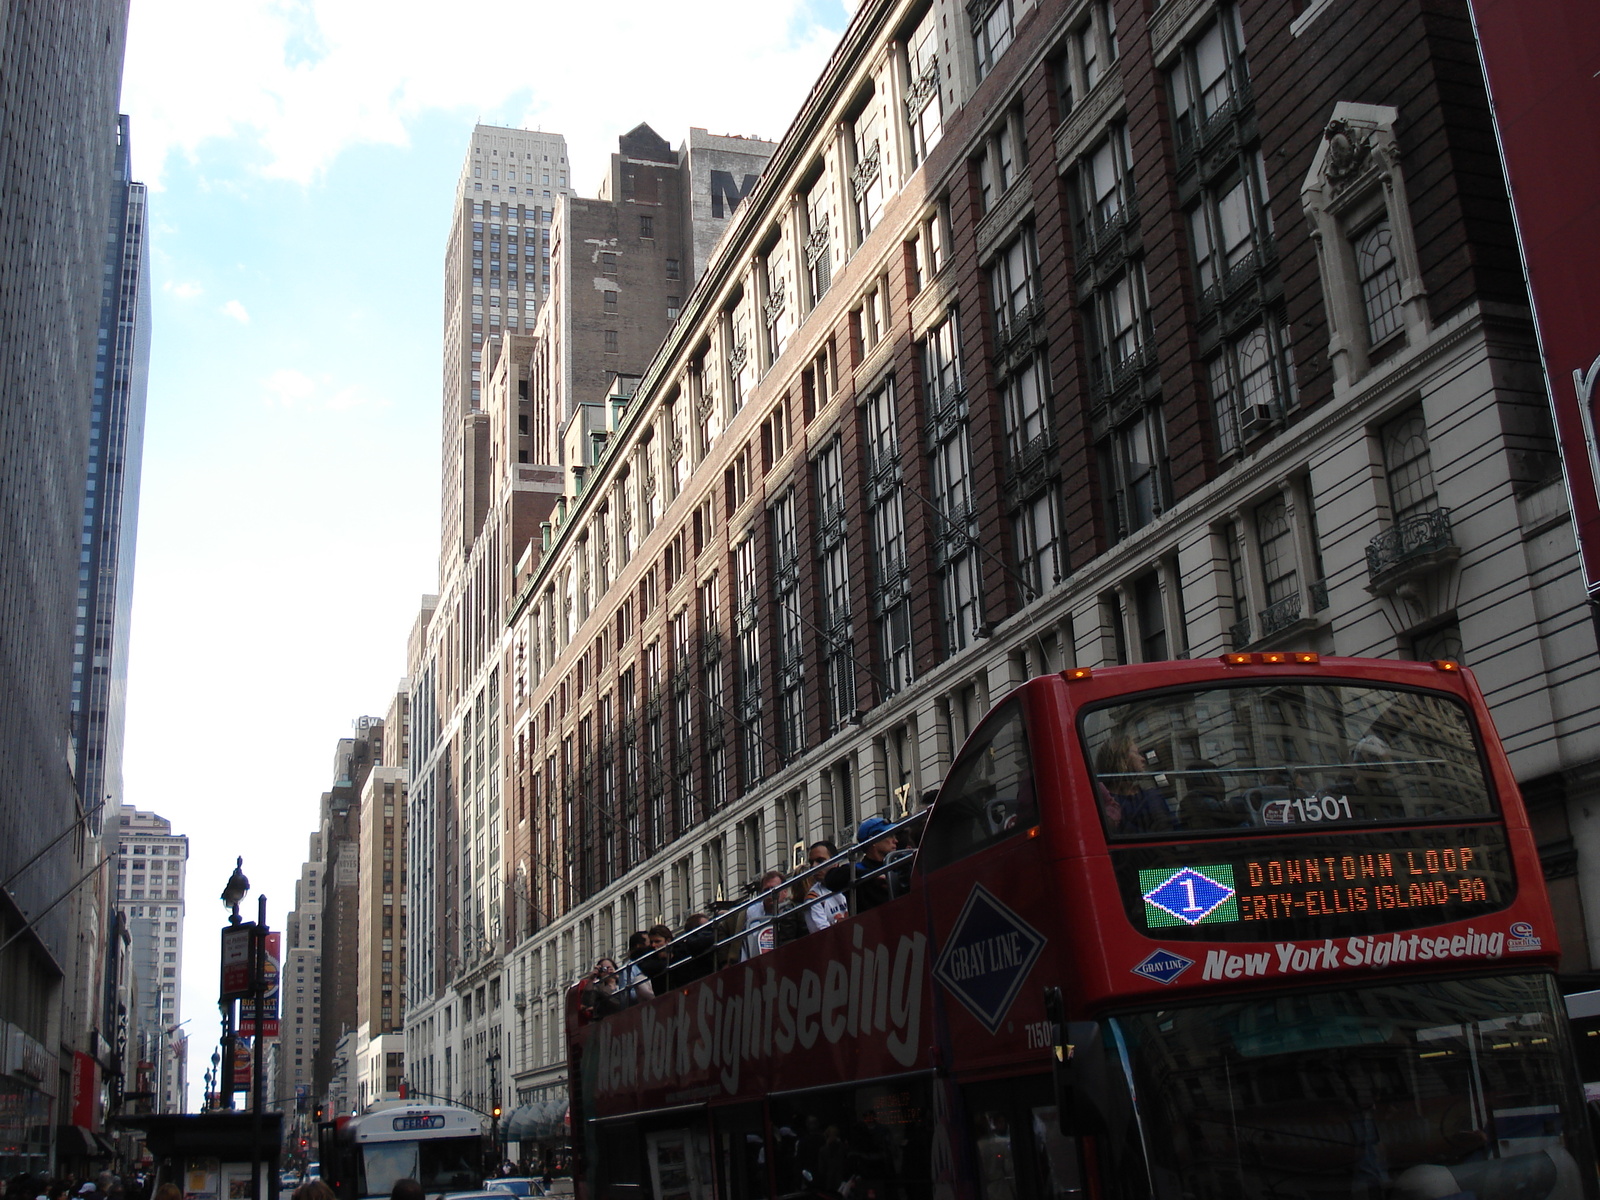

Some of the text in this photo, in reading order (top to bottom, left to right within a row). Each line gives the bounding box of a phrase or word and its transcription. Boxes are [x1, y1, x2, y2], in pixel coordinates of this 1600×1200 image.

[1275, 795, 1352, 823] 71501
[1248, 847, 1474, 888] DOWNTOWN LOOP
[1179, 878, 1202, 912] 1
[950, 931, 1023, 982] GRAY LINE
[1142, 959, 1184, 973] GRAY LINE
[1202, 927, 1505, 981] New York Sightseeing
[597, 923, 927, 1096] New York Sightseeing
[403, 1117, 437, 1129] FERRY
